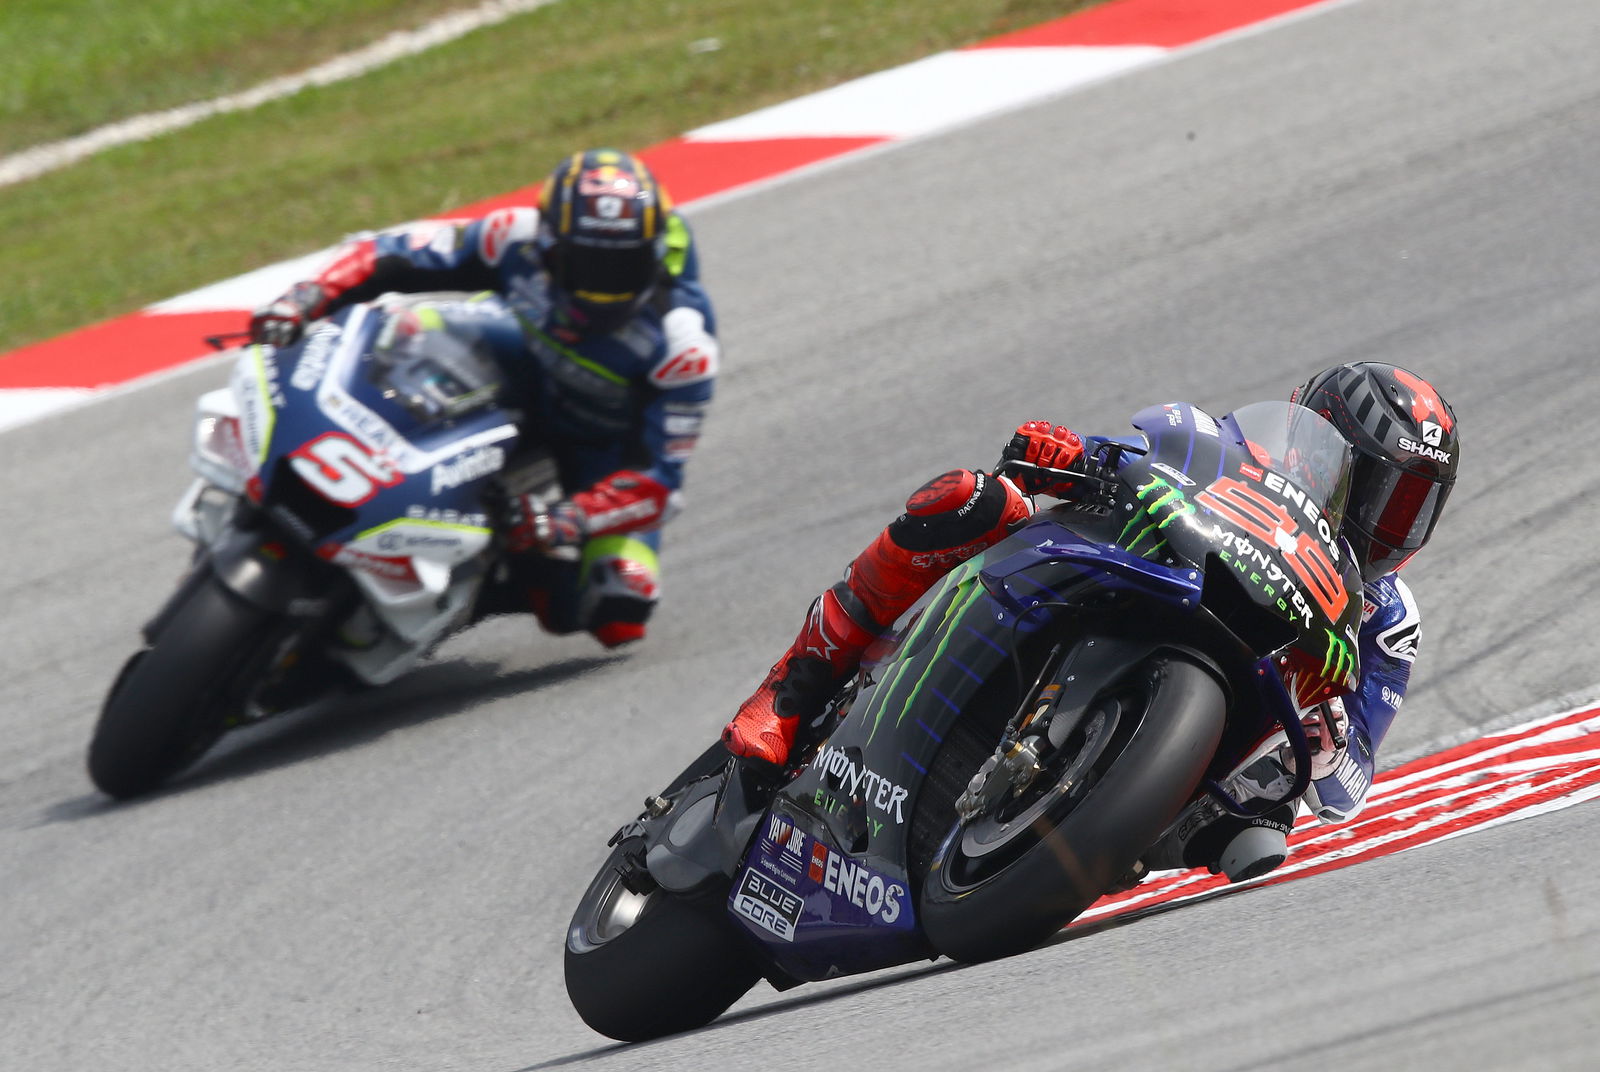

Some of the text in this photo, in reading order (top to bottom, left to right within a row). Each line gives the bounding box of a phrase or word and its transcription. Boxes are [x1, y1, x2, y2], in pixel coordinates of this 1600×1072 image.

[1397, 436, 1451, 465] SHARK
[957, 491, 981, 517] RACING
[1263, 471, 1340, 563] ENEOS
[1209, 523, 1315, 629] MONSTER
[1219, 551, 1298, 622] ENERGY
[812, 744, 909, 825] MONTER
[1335, 753, 1369, 805] AMAHA
[740, 896, 788, 936] CORE
[748, 874, 796, 914] BLUE
[823, 850, 905, 924] ENEOS
